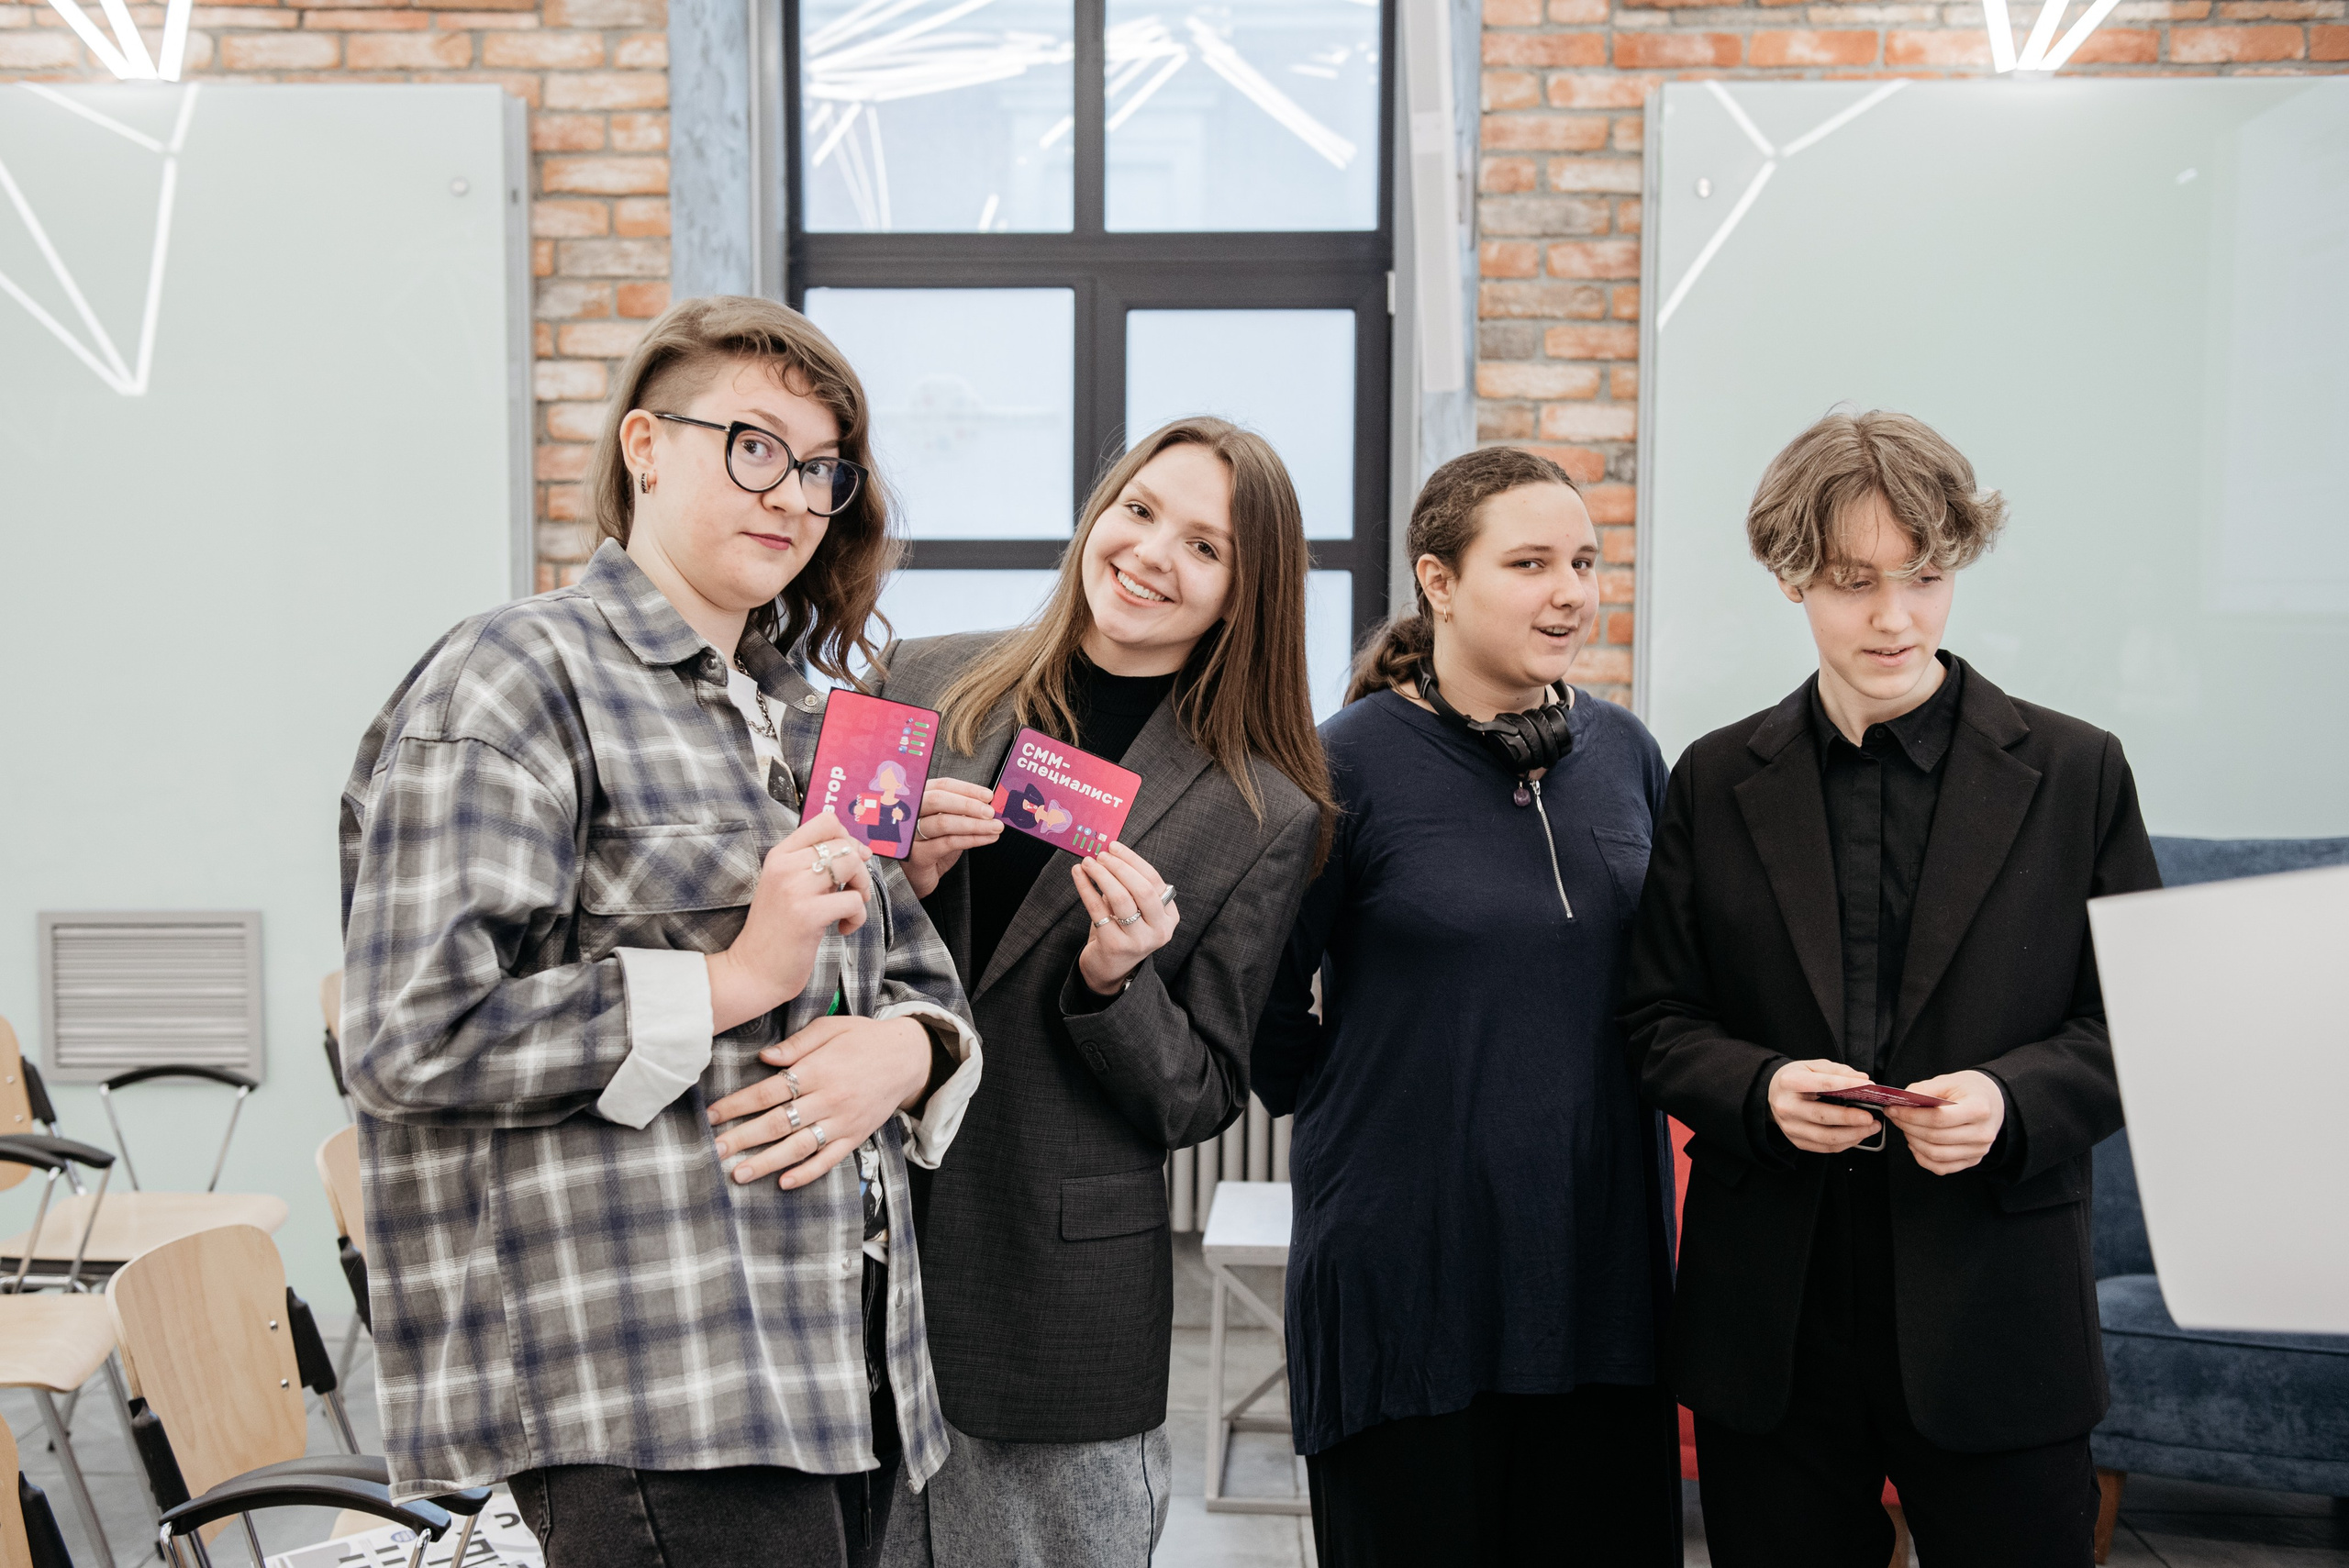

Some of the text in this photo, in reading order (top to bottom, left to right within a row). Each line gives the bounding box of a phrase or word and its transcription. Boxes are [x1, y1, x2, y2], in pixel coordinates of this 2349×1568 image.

[1021, 742, 1071, 770] СММ-
[822, 766, 847, 814] втор
[1017, 757, 1123, 808] специалист
